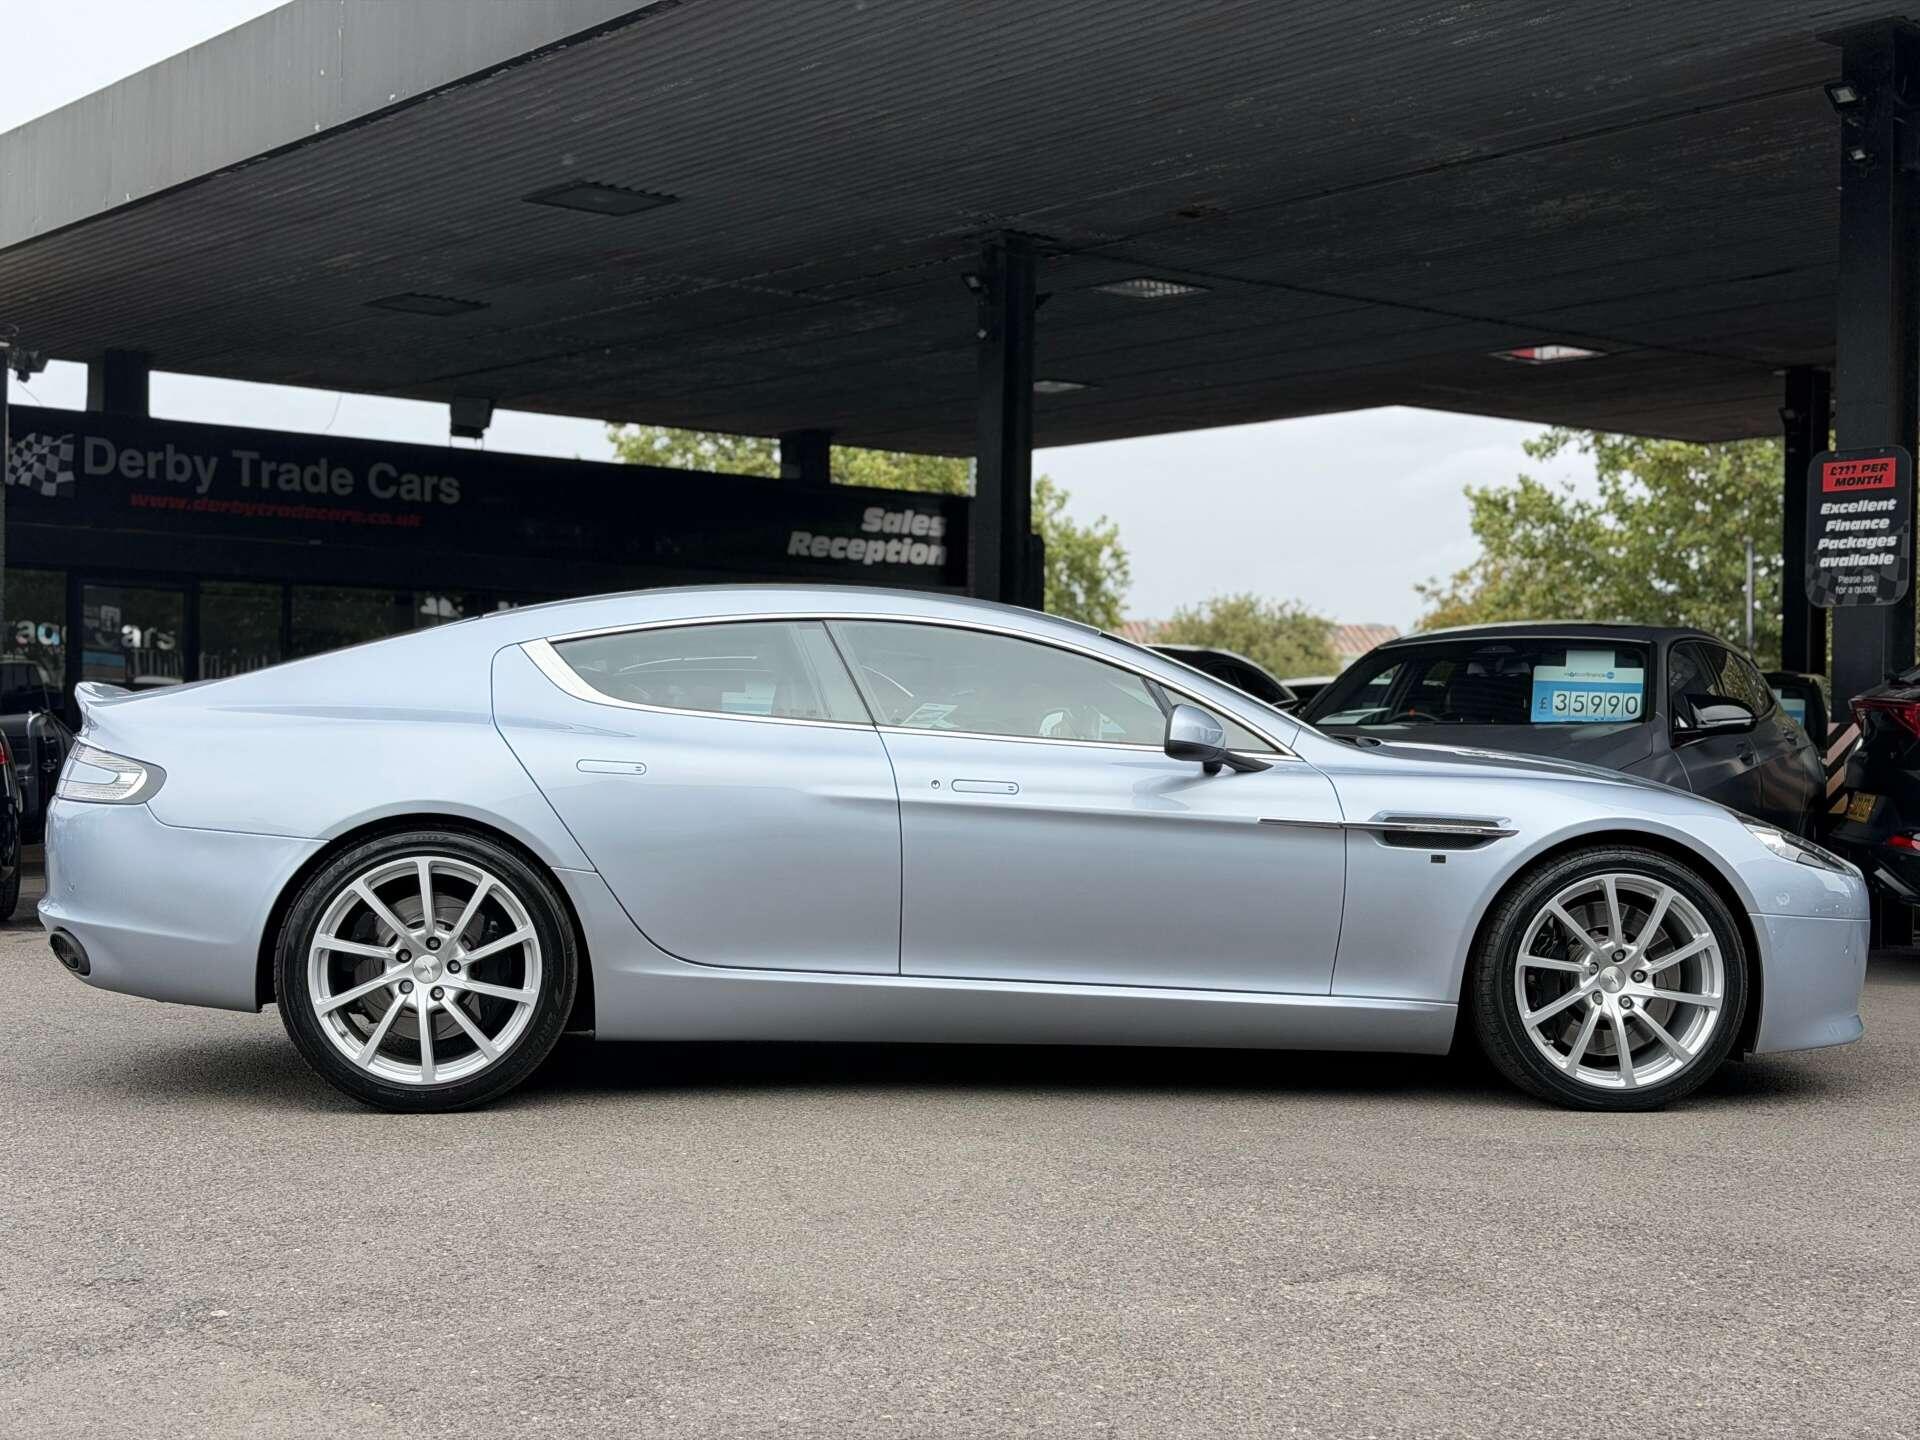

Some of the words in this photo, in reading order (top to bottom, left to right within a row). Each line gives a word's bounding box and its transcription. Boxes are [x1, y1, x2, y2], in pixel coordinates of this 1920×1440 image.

[84, 436, 218, 493] Derby
[232, 449, 354, 497] Trade
[368, 462, 462, 504] Cars
[1861, 463, 1889, 474] PER
[1834, 475, 1884, 487] MONTH
[1820, 498, 1897, 515] Excellent
[861, 506, 947, 537] Sales
[1825, 517, 1890, 532] Finance
[787, 531, 947, 566] Reception
[1817, 535, 1897, 550] Packages
[1819, 552, 1895, 568] available
[1838, 575, 1861, 584] Please
[1862, 574, 1875, 583] ask
[1836, 585, 1847, 594] for
[1854, 585, 1878, 595] quote
